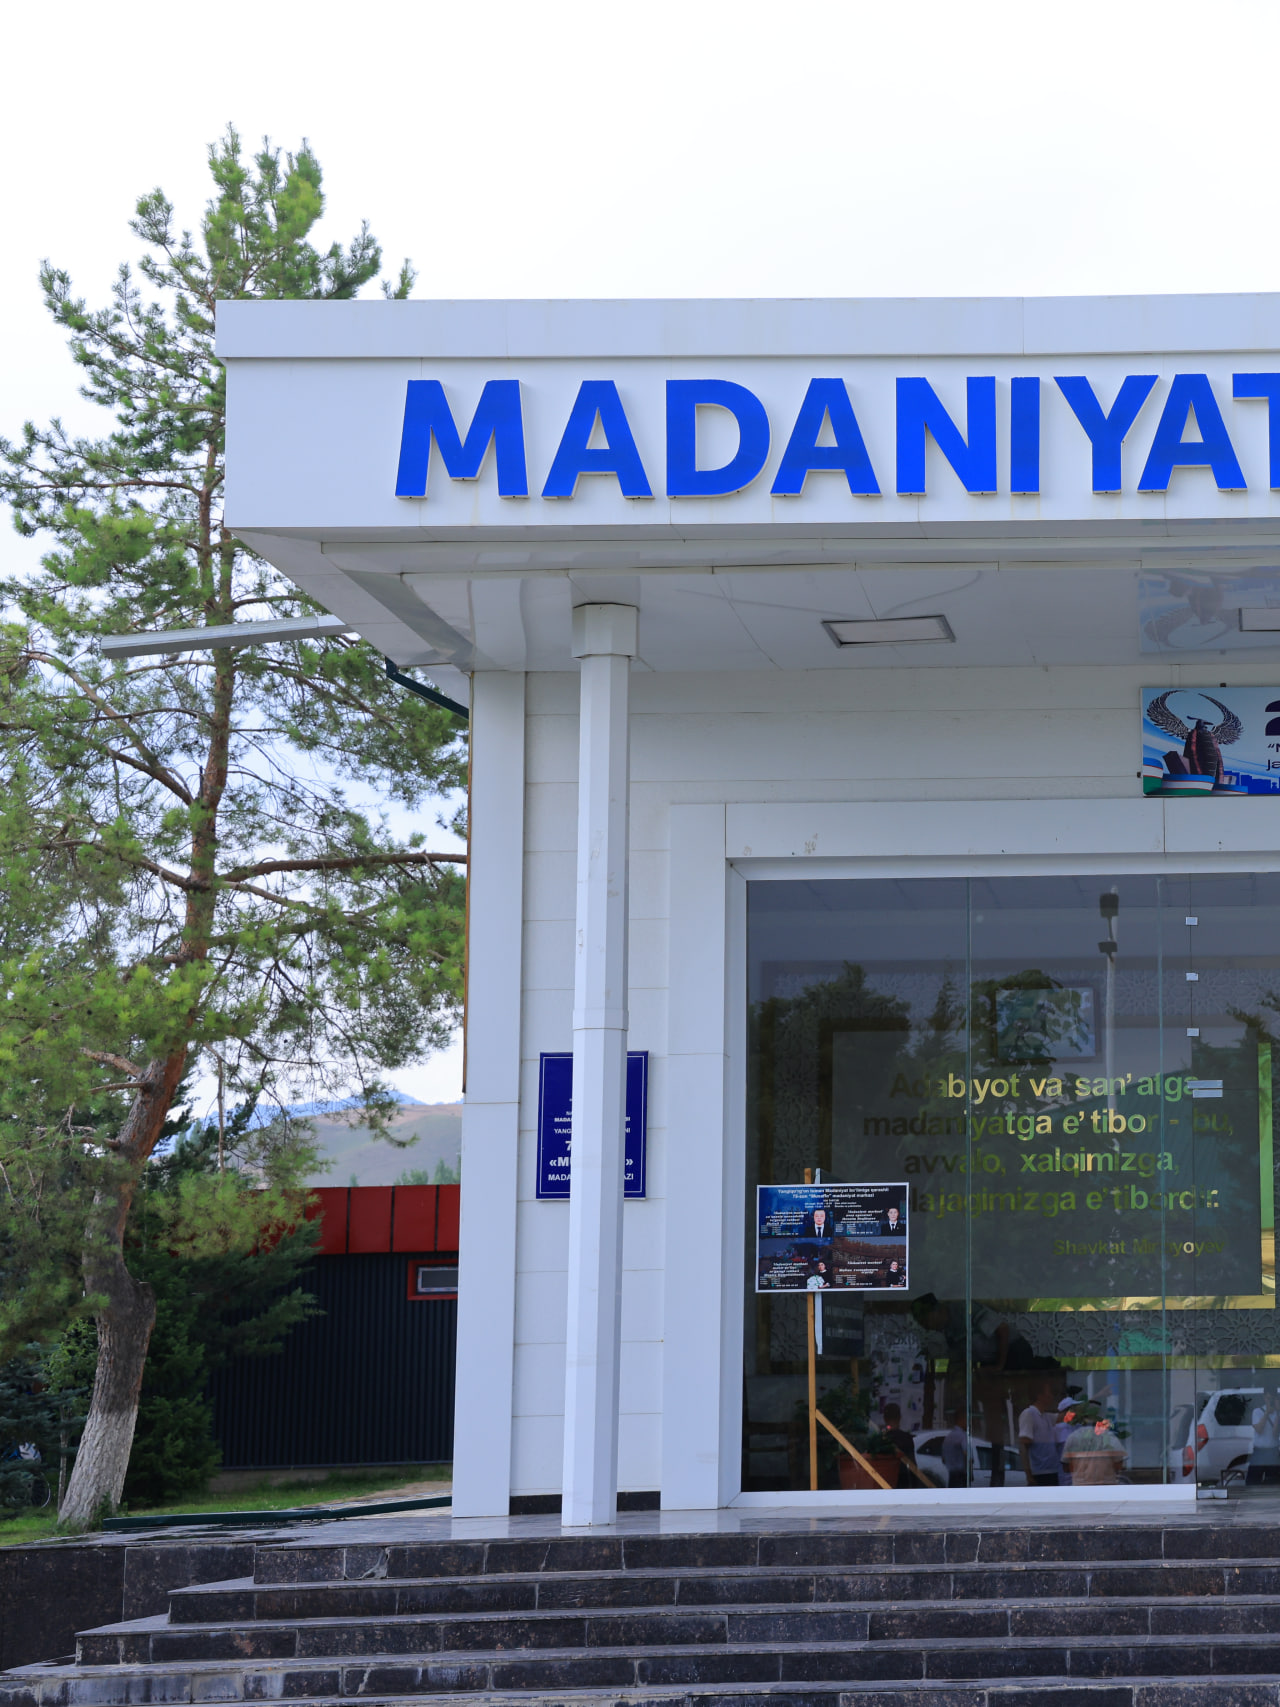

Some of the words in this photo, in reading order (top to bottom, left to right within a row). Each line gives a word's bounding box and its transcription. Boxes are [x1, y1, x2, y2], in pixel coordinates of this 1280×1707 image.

[889, 1072, 1021, 1105] Adabiyot
[1029, 1077, 1062, 1096] va
[863, 1109, 1053, 1142] madaniyatga
[1193, 1107, 1234, 1137] bu,
[903, 1147, 1007, 1178] avvalo,
[1020, 1146, 1180, 1179] xalqimizga,
[1053, 1239, 1127, 1256] Shavkat
